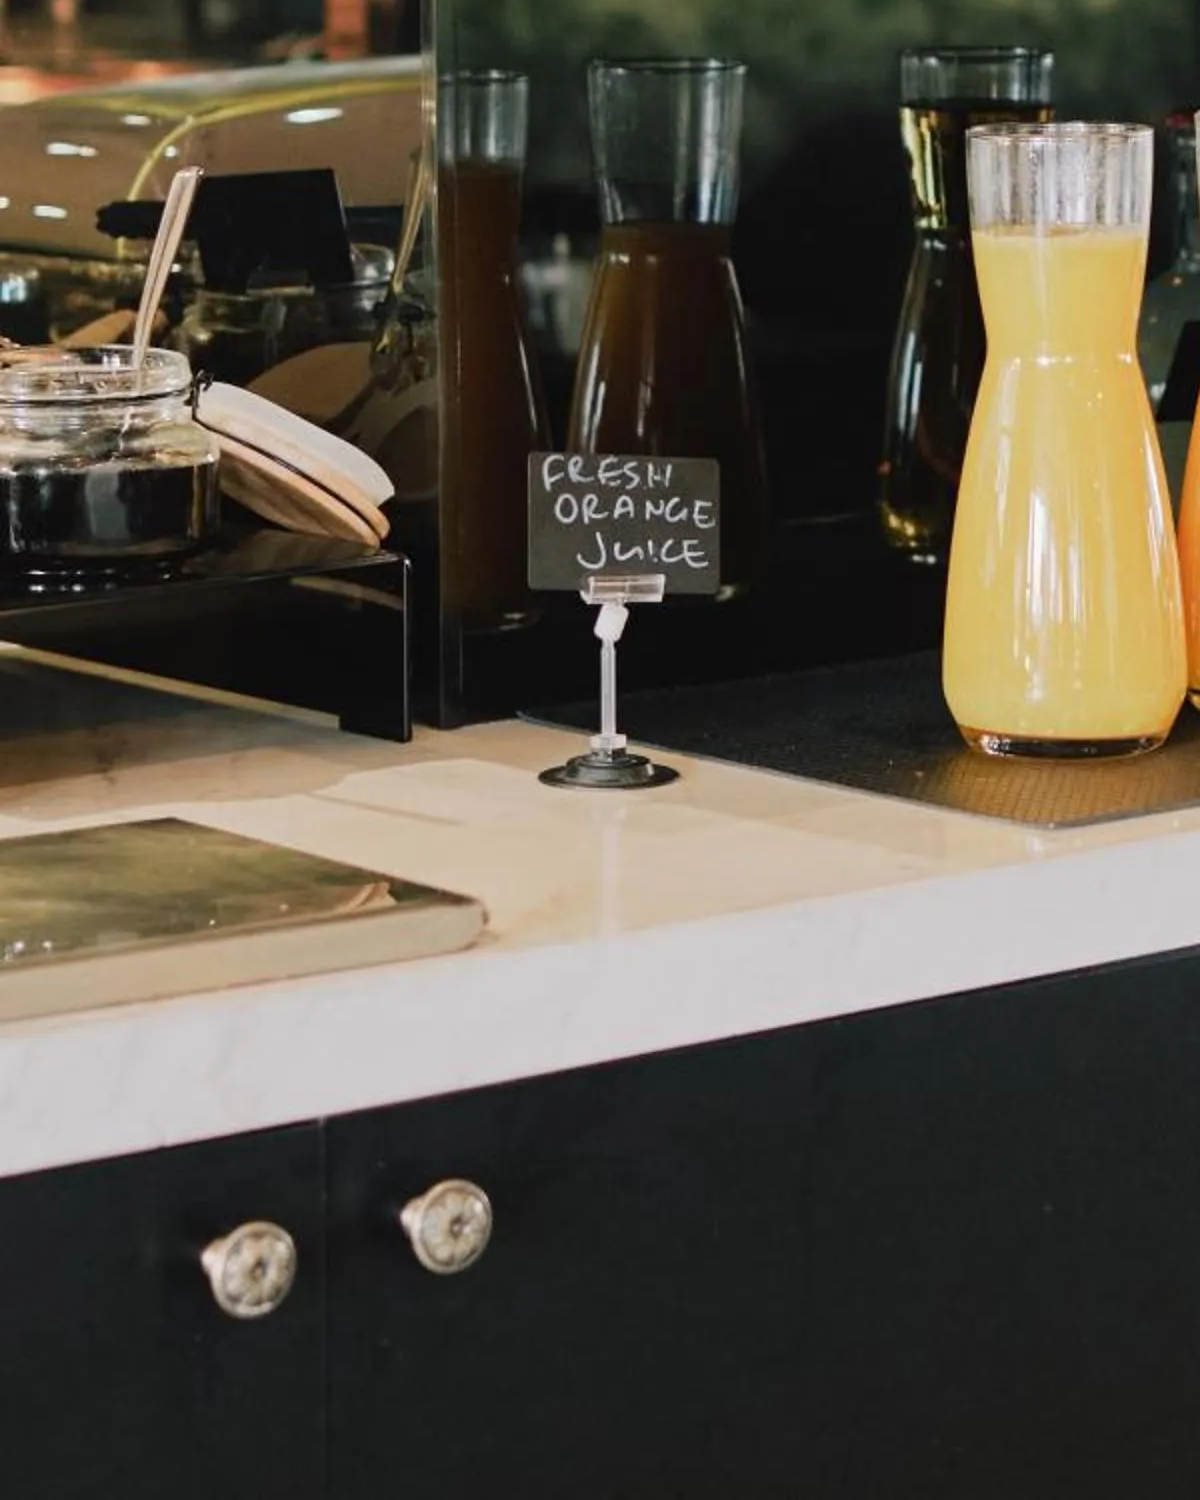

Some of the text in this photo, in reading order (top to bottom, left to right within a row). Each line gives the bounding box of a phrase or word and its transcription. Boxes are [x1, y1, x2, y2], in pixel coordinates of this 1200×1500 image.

[542, 454, 672, 491] FRESH
[554, 494, 716, 528] ORANGE
[577, 532, 709, 569] JUICE
